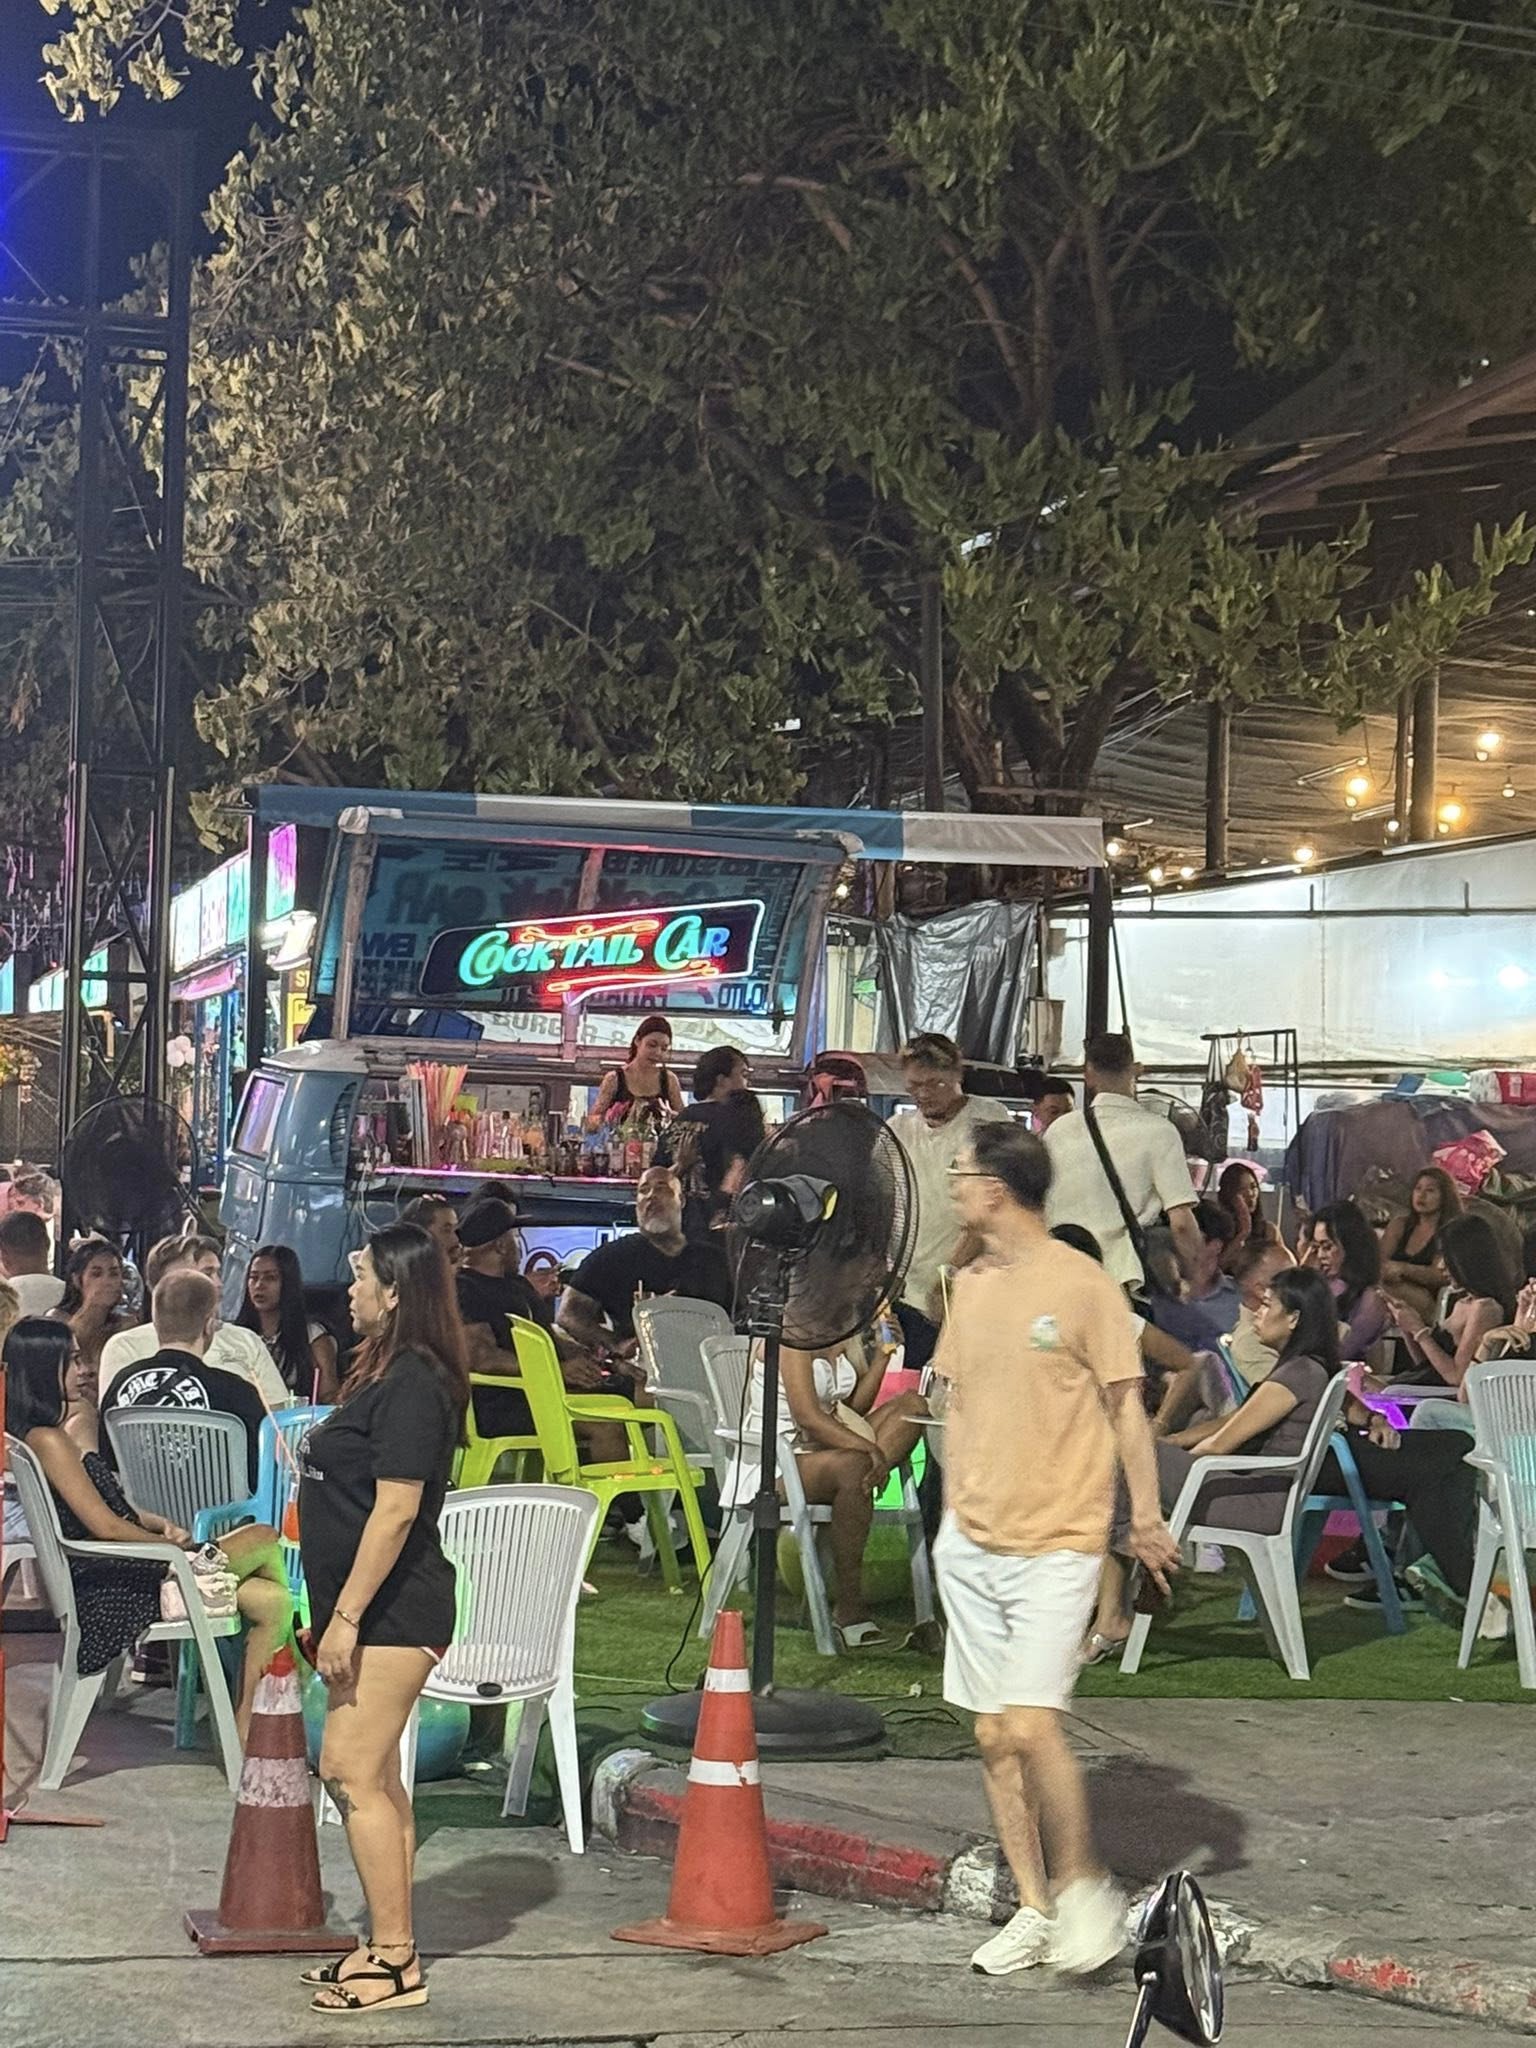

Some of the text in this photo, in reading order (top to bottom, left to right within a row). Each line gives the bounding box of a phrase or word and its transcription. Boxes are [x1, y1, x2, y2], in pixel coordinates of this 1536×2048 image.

[459, 930, 643, 986] COCKTAIL
[654, 915, 730, 970] CAR
[493, 1012, 598, 1044] BURGR
